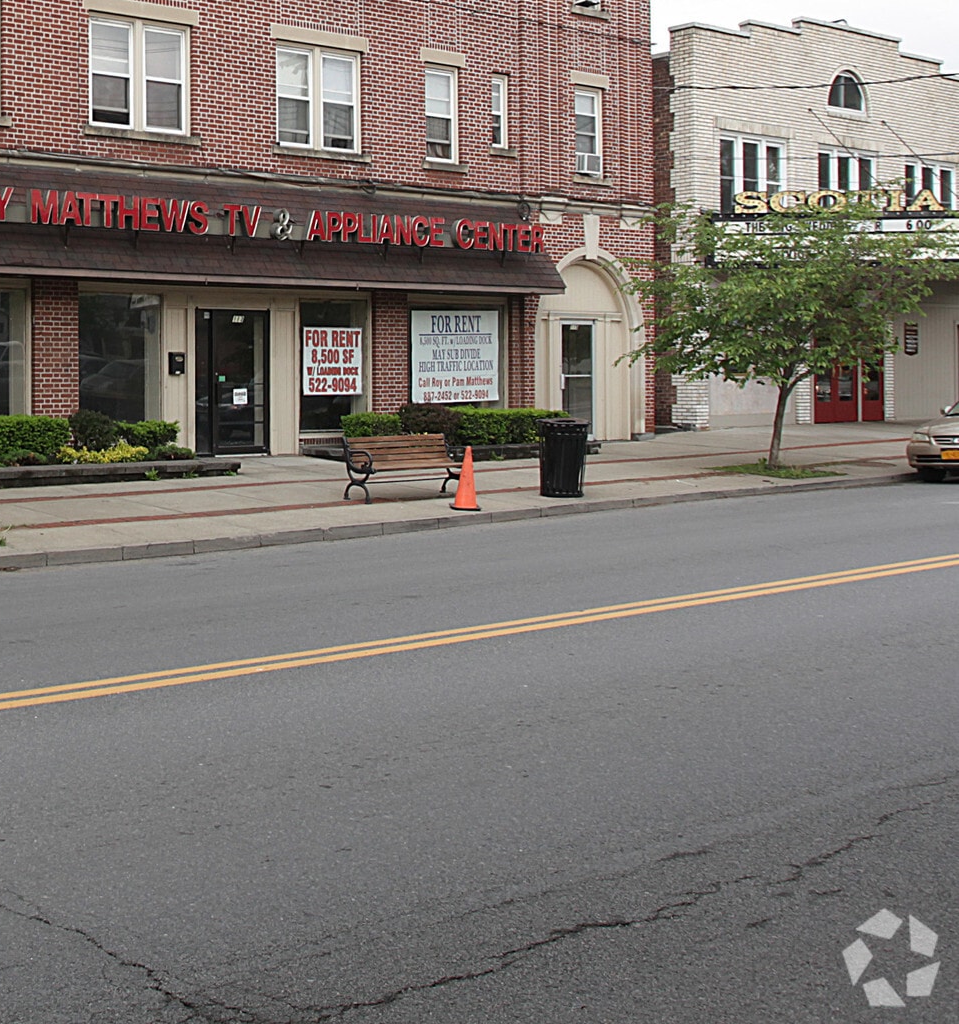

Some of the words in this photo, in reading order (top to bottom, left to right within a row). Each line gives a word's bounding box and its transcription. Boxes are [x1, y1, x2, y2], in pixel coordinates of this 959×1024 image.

[28, 188, 210, 236] MATTHEWS
[222, 203, 262, 238] TV
[270, 207, 293, 241] &
[306, 210, 446, 248] APPLIANCE
[453, 217, 545, 253] CENTER
[430, 314, 452, 333] FOR
[454, 315, 482, 333] RENT
[305, 329, 328, 347] FOR
[331, 330, 361, 348] RENT
[478, 336, 493, 345] DOCK
[311, 349, 340, 366] 8,500
[342, 349, 355, 364] SF
[432, 349, 446, 360] MAY
[447, 349, 459, 359] SUB
[460, 348, 481, 359] DIVIDE
[317, 366, 342, 376] LOADING
[343, 366, 359, 376] DOCK
[418, 361, 435, 372] HIGH
[437, 360, 463, 372] TRAFFIC
[463, 360, 494, 371] LOCATION
[308, 377, 358, 392] 522-9094
[418, 377, 430, 387] Call
[431, 377, 443, 389] Roy
[444, 379, 451, 387] or
[451, 377, 465, 386] Pam
[465, 376, 493, 386] Matthews
[453, 392, 460, 400] or
[461, 390, 489, 400] 522-9094
